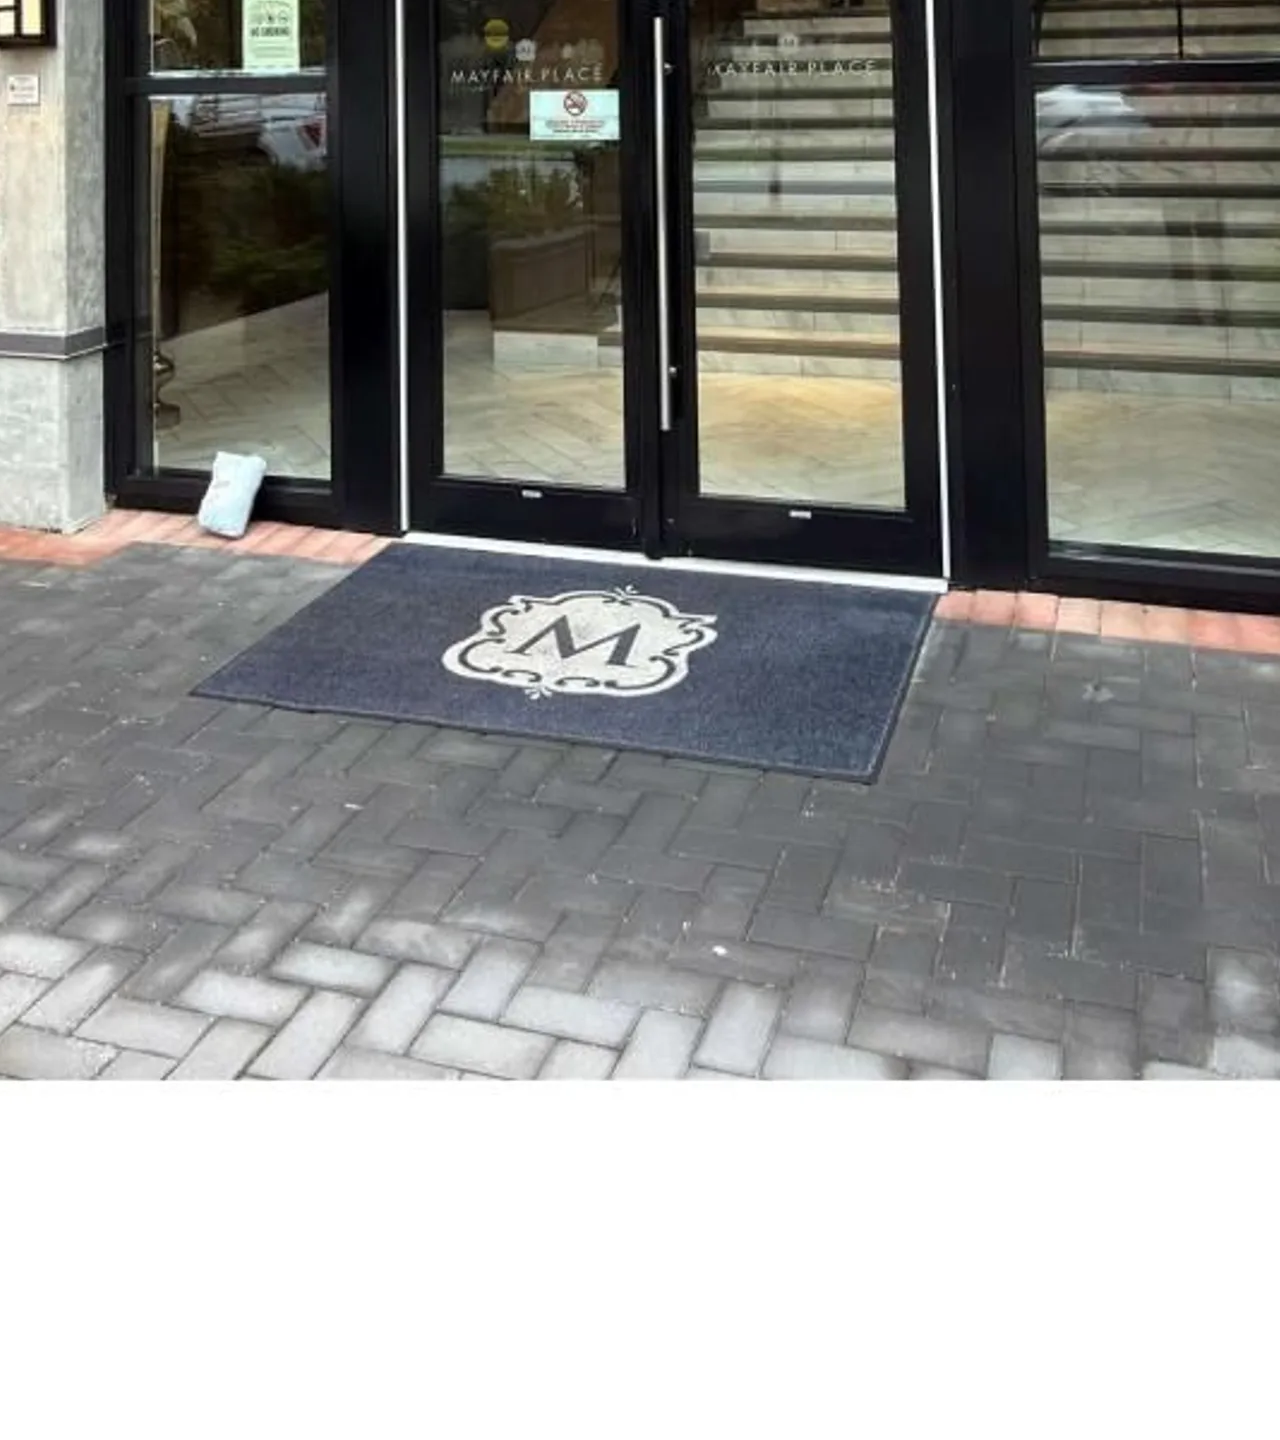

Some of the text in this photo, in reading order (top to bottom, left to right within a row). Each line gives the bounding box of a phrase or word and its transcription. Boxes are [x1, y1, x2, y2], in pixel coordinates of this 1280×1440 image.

[450, 62, 603, 84] MAYFAIR PLACE
[707, 60, 876, 77] MAYFAIR PLACE
[505, 615, 640, 668] M
